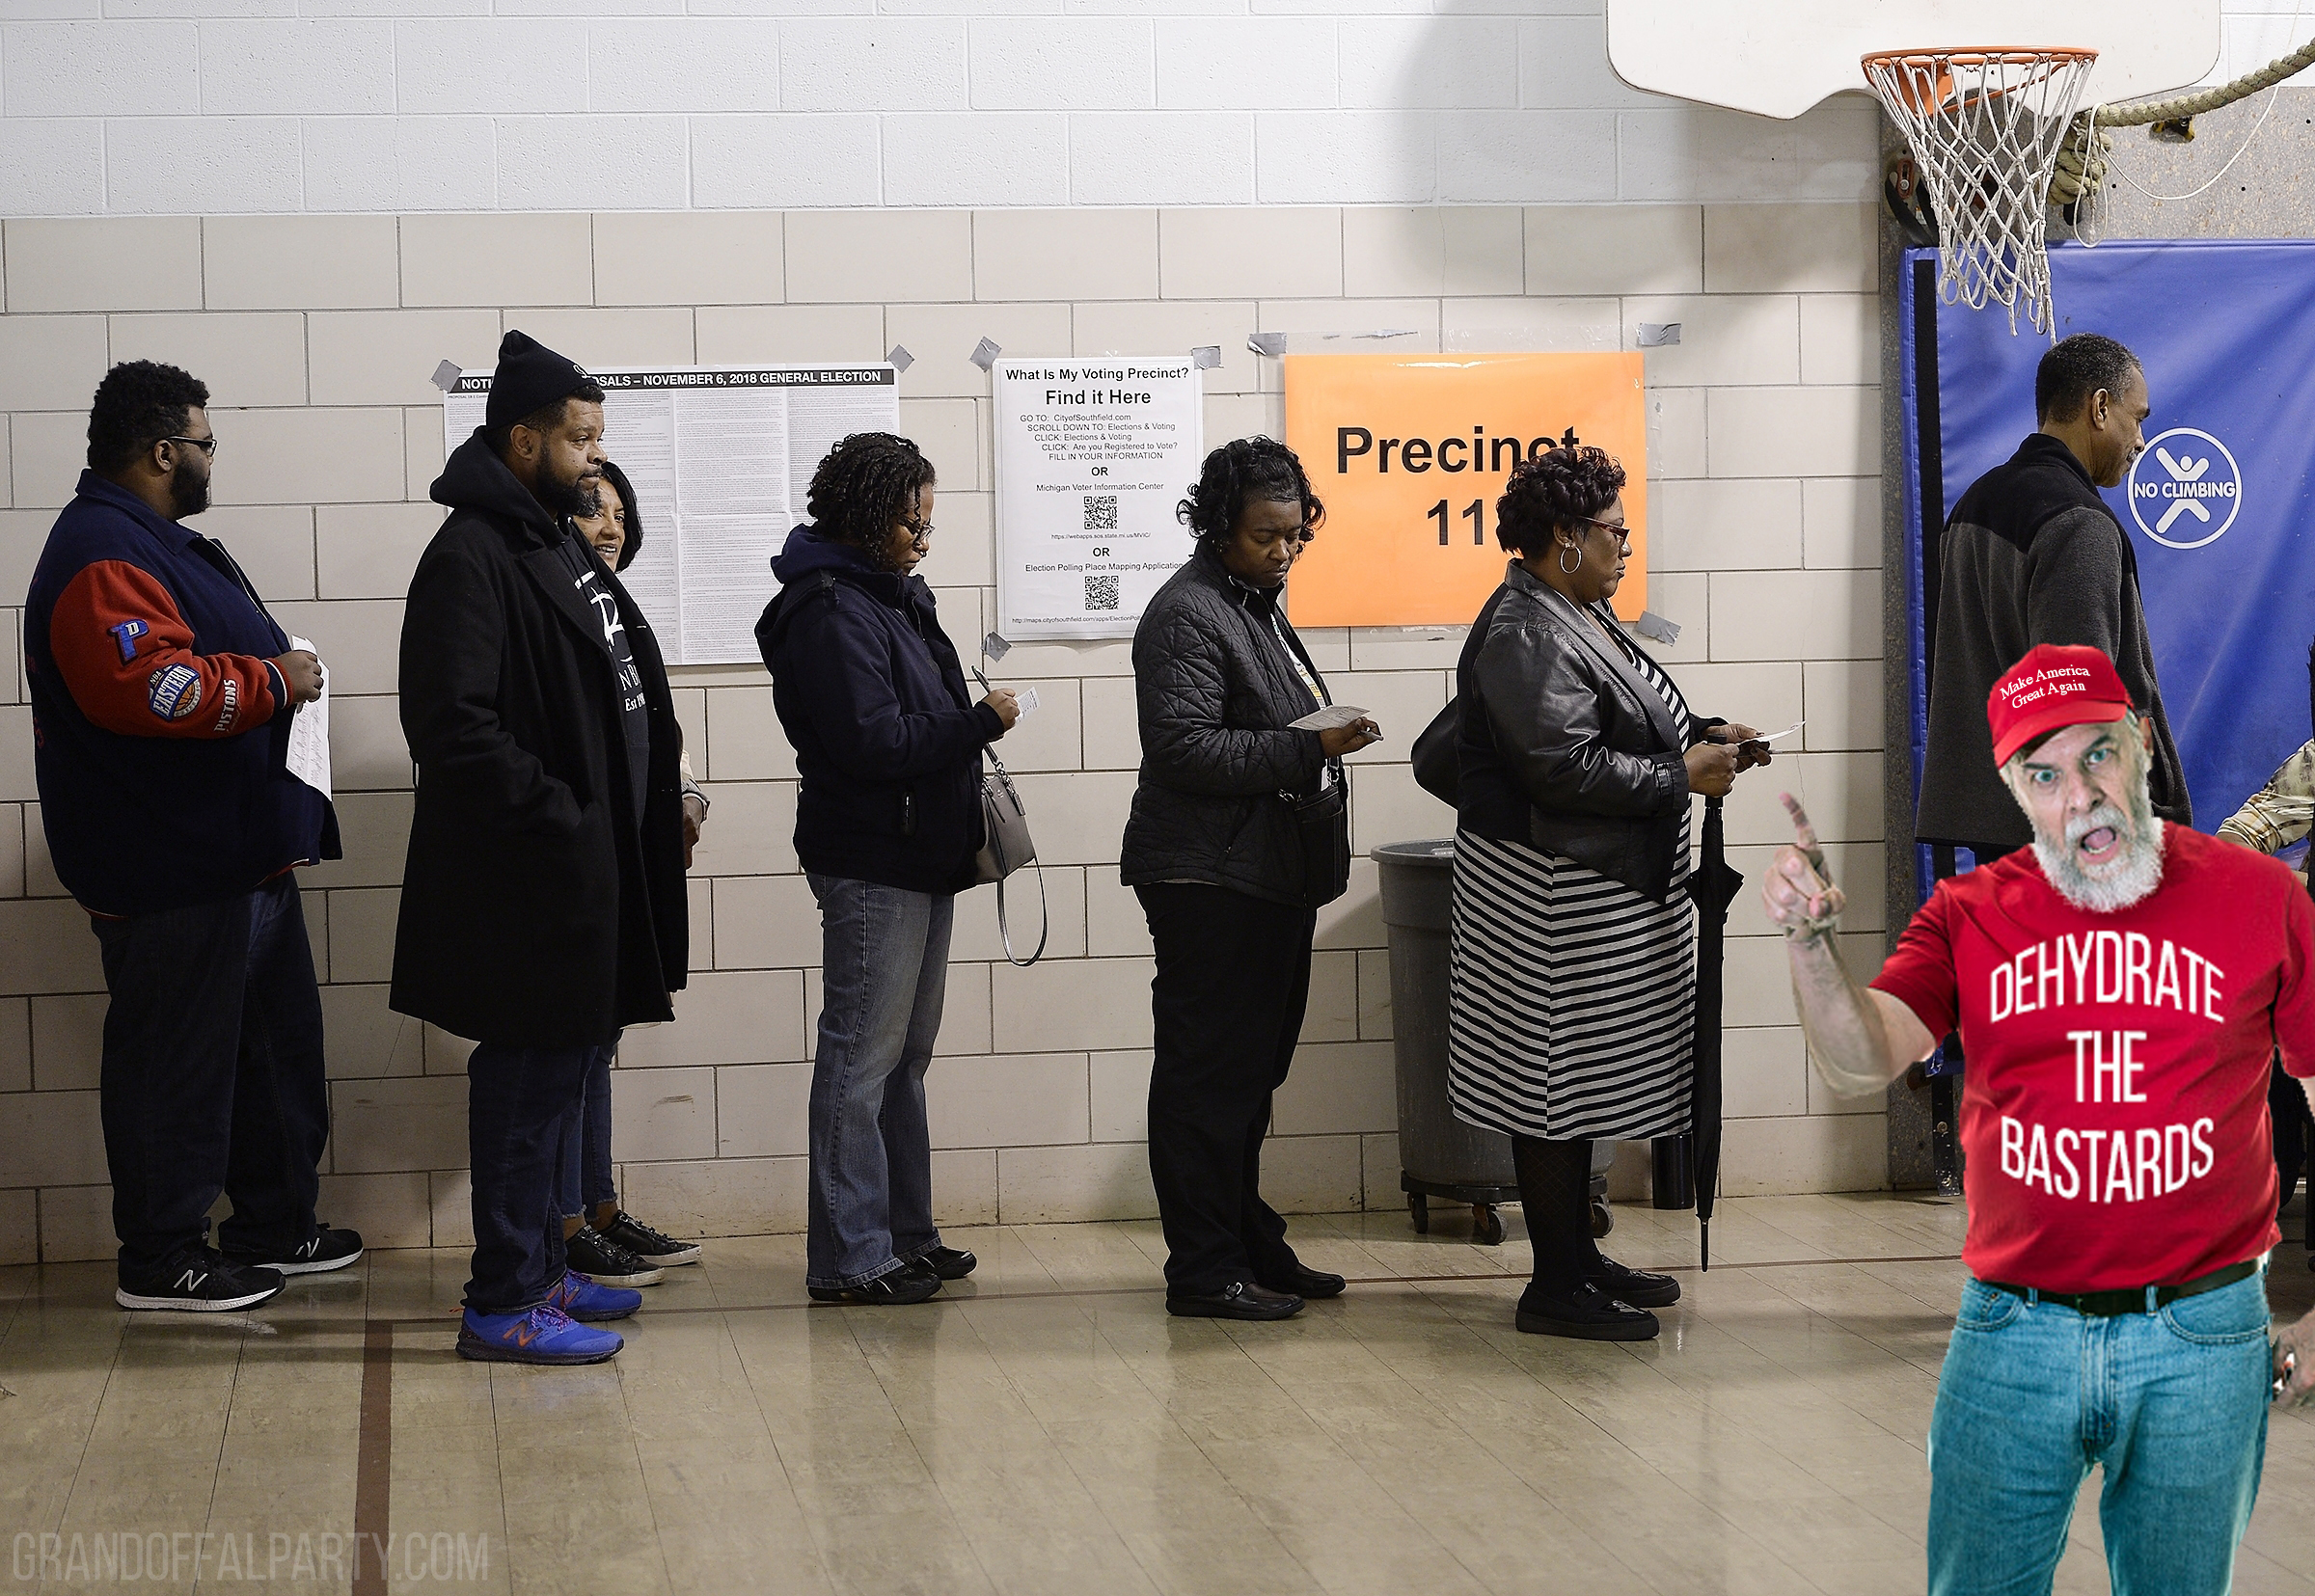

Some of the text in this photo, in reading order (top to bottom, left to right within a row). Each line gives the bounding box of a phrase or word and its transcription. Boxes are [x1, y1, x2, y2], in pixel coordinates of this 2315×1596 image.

[461, 378, 492, 391] NOTI
[642, 372, 714, 387] NOVEMBER
[716, 373, 726, 387] 6,
[729, 372, 757, 386] 2018
[759, 370, 818, 385] GENERAL
[820, 370, 881, 384] ELECTION
[1006, 367, 1189, 382] What Is My Voting Precinct?
[1046, 389, 1152, 405] Find it Here
[1053, 414, 1131, 422] CityofSouthfield.com
[1027, 423, 1061, 432] SCROLL
[1107, 422, 1143, 431] Elections
[1144, 422, 1150, 431] &
[1152, 422, 1176, 432] Voting
[1034, 433, 1062, 442] CLICK:
[1064, 433, 1099, 442] Elections
[1107, 433, 1132, 442] Voting
[1042, 443, 1070, 451] CLICK:
[1088, 444, 1103, 452] you
[1104, 442, 1145, 451] Registered
[1104, 451, 1163, 460] INFORMATION
[1091, 467, 1109, 476] OR
[1036, 484, 1070, 494] Michigan
[1094, 483, 1137, 492] Information
[2135, 481, 2236, 499] NO CLIMBING
[1427, 499, 1484, 546] 11
[1093, 547, 1110, 557] OR
[1025, 563, 1056, 572] Election
[1057, 563, 1083, 572] Polling
[1085, 562, 1106, 571] Place
[1108, 562, 1141, 572] Mapping
[2000, 663, 2091, 700] Make America
[2011, 680, 2086, 709] Great Again
[214, 679, 237, 733] PISTONS
[1991, 931, 2224, 1023] DEHYDRATE
[2066, 1030, 2147, 1102] THE
[2001, 1115, 2215, 1204] BASTARDS
